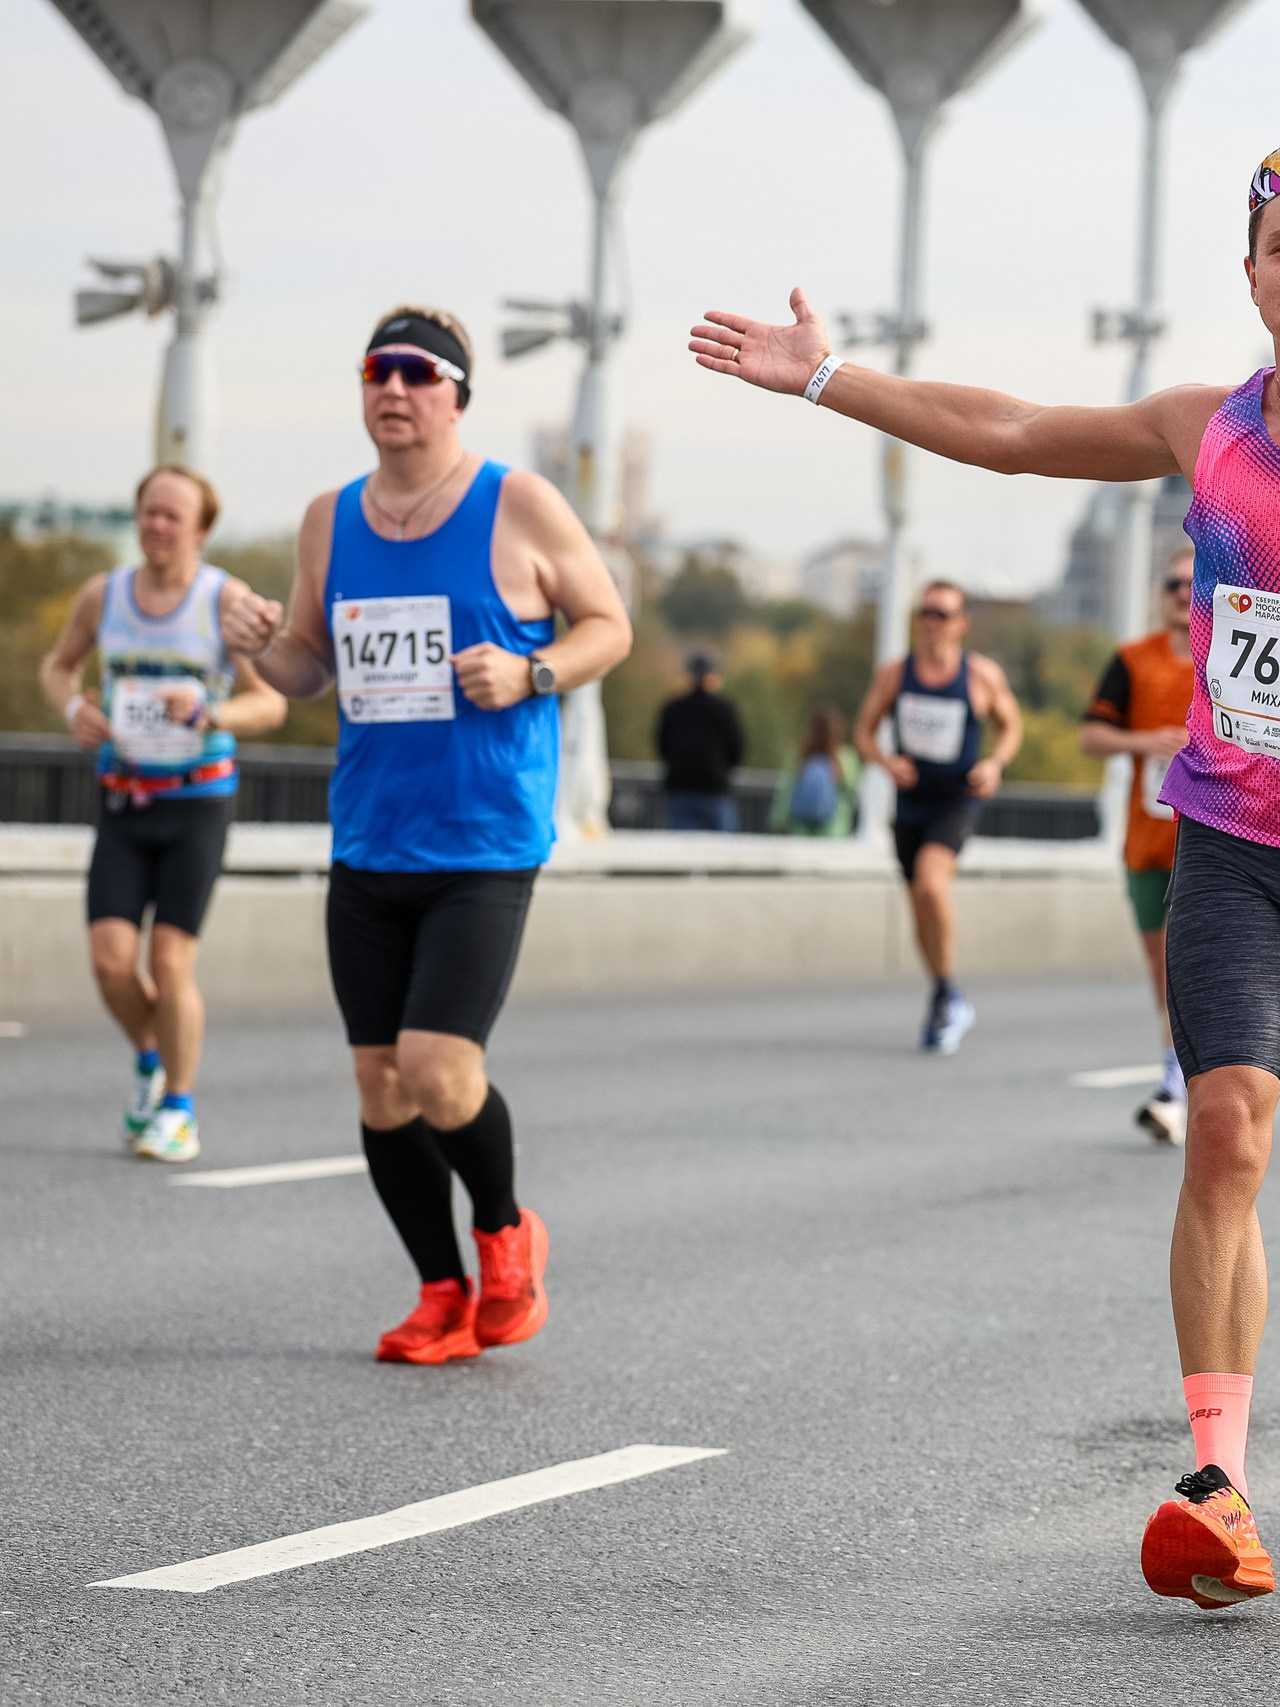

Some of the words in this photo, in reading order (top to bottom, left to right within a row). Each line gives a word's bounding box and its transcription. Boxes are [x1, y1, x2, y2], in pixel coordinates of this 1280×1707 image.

[811, 365, 830, 388] 7677
[342, 630, 445, 669] 14715
[1189, 1408, 1223, 1422] cep
